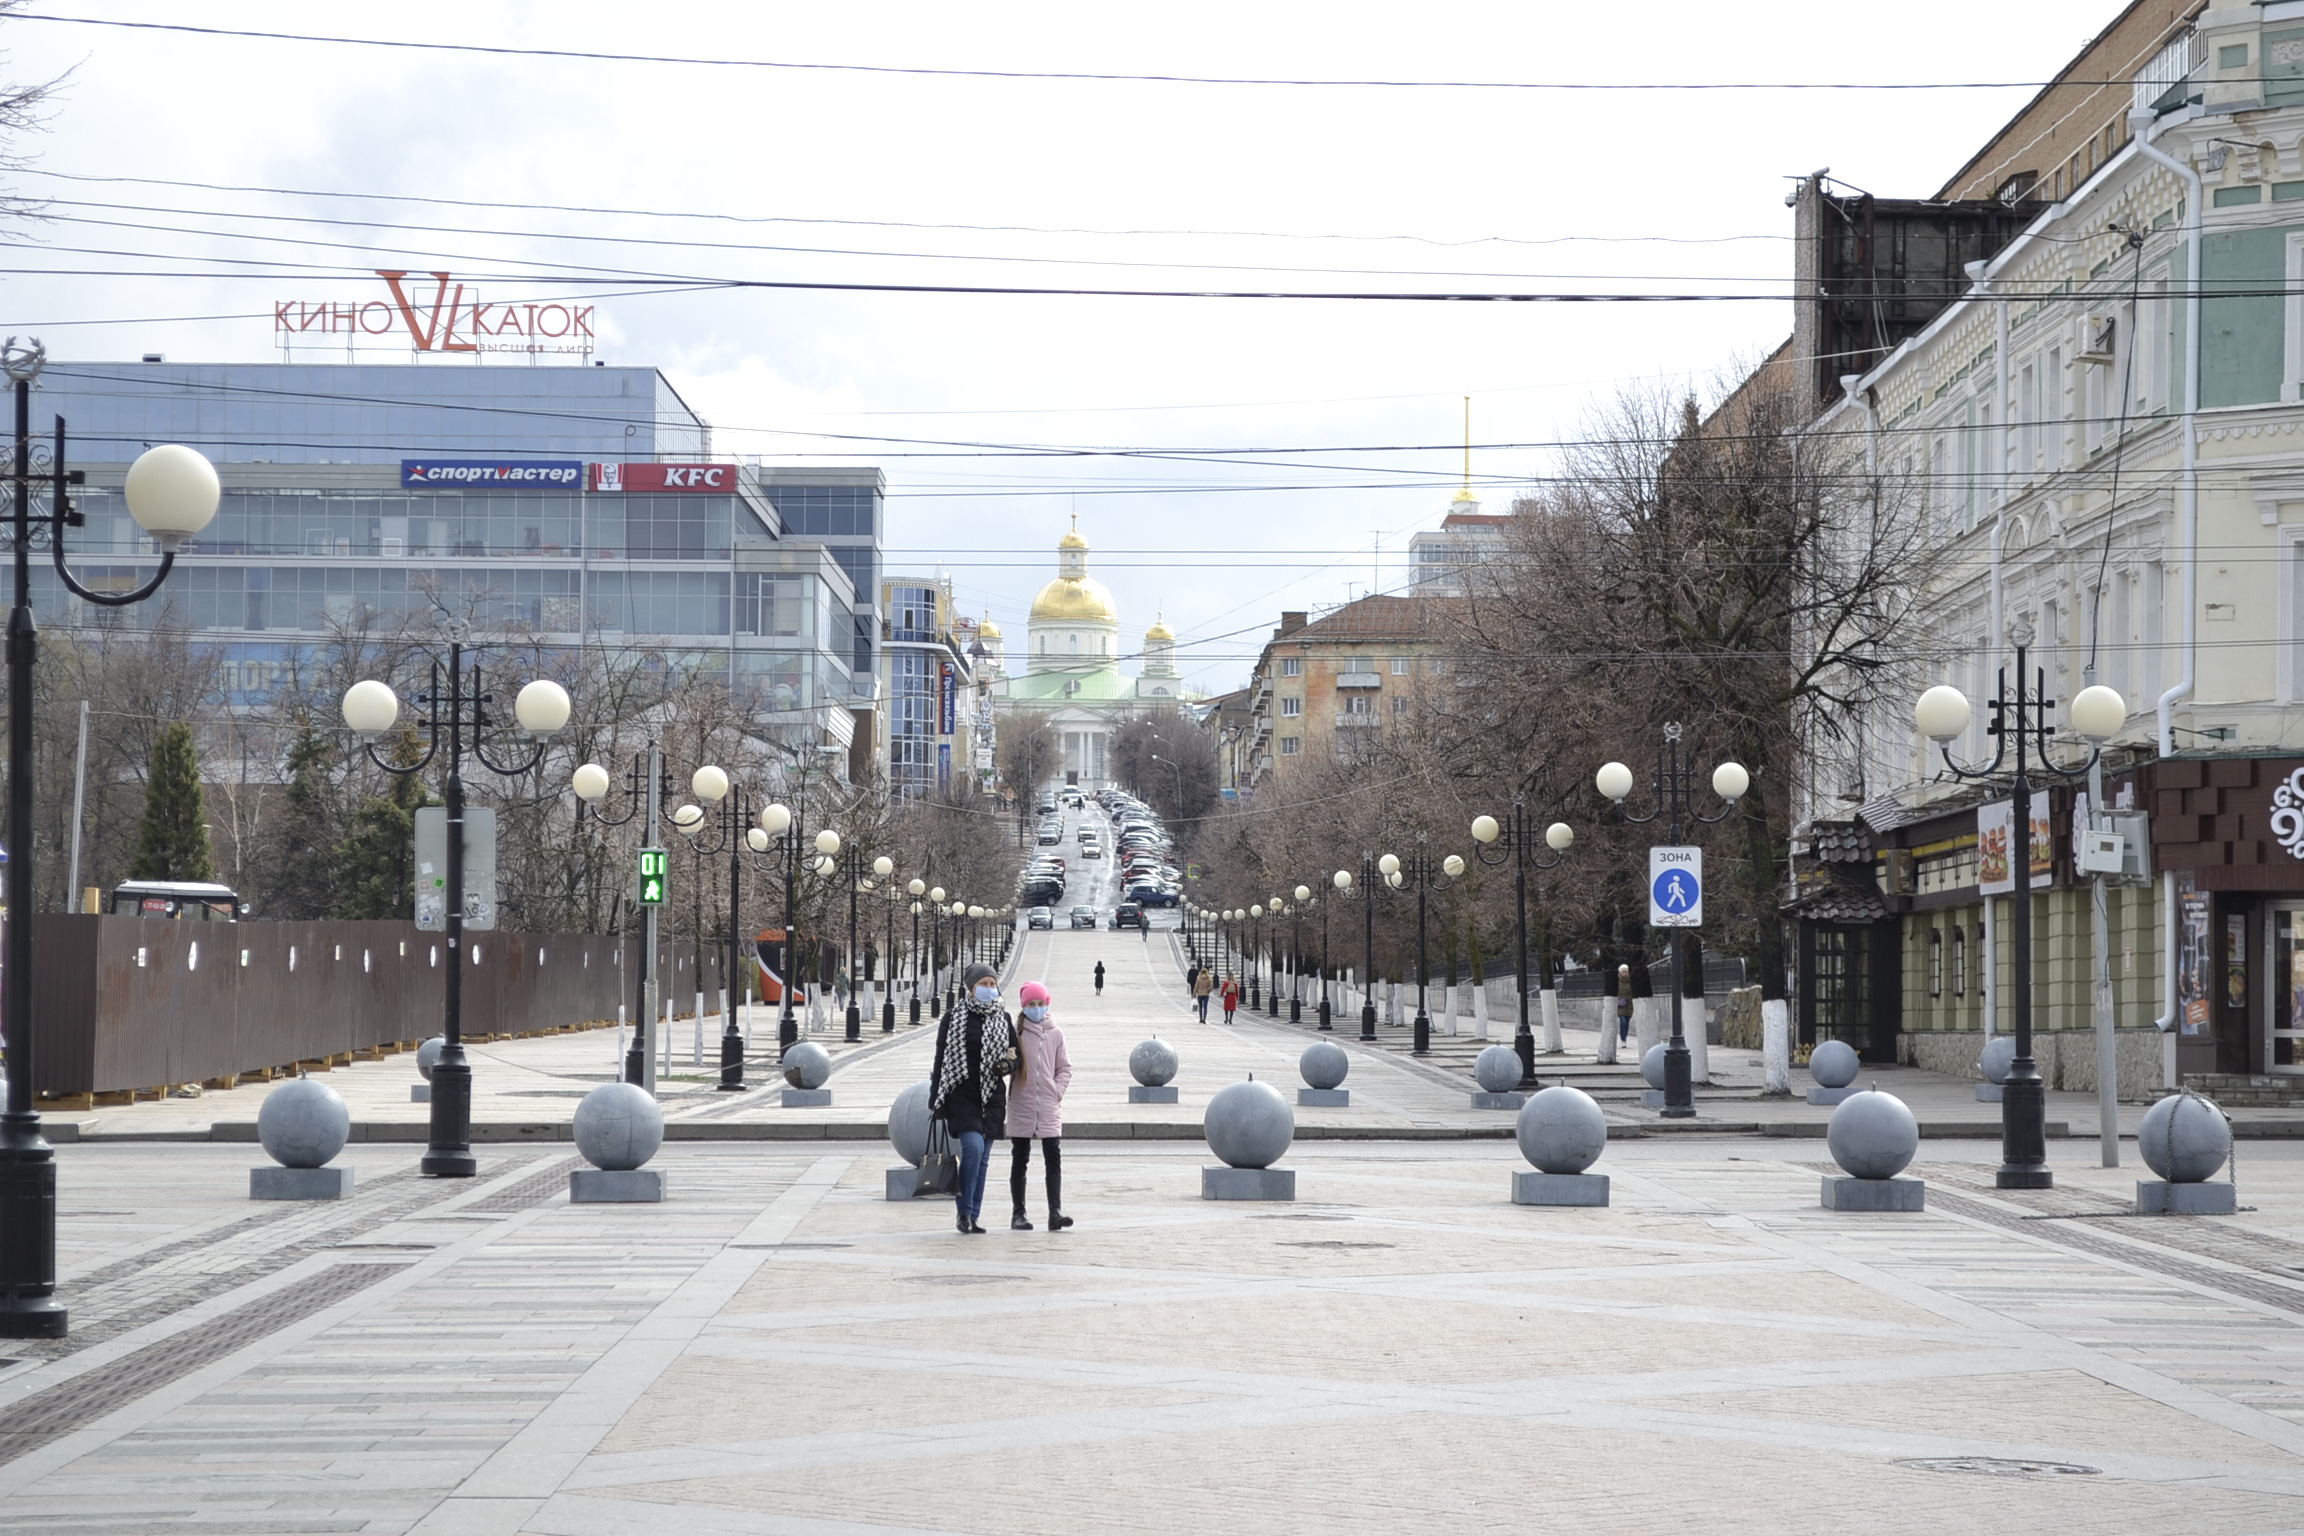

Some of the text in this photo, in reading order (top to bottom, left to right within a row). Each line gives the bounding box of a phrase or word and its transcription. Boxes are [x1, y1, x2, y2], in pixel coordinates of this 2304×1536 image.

[274, 300, 393, 334] КИНО
[472, 303, 595, 337] КАТОК
[663, 467, 724, 487] KFC
[944, 676, 953, 734] Промсвязьбанк
[641, 854, 664, 876] 01
[1660, 852, 1692, 863] ЗОНА
